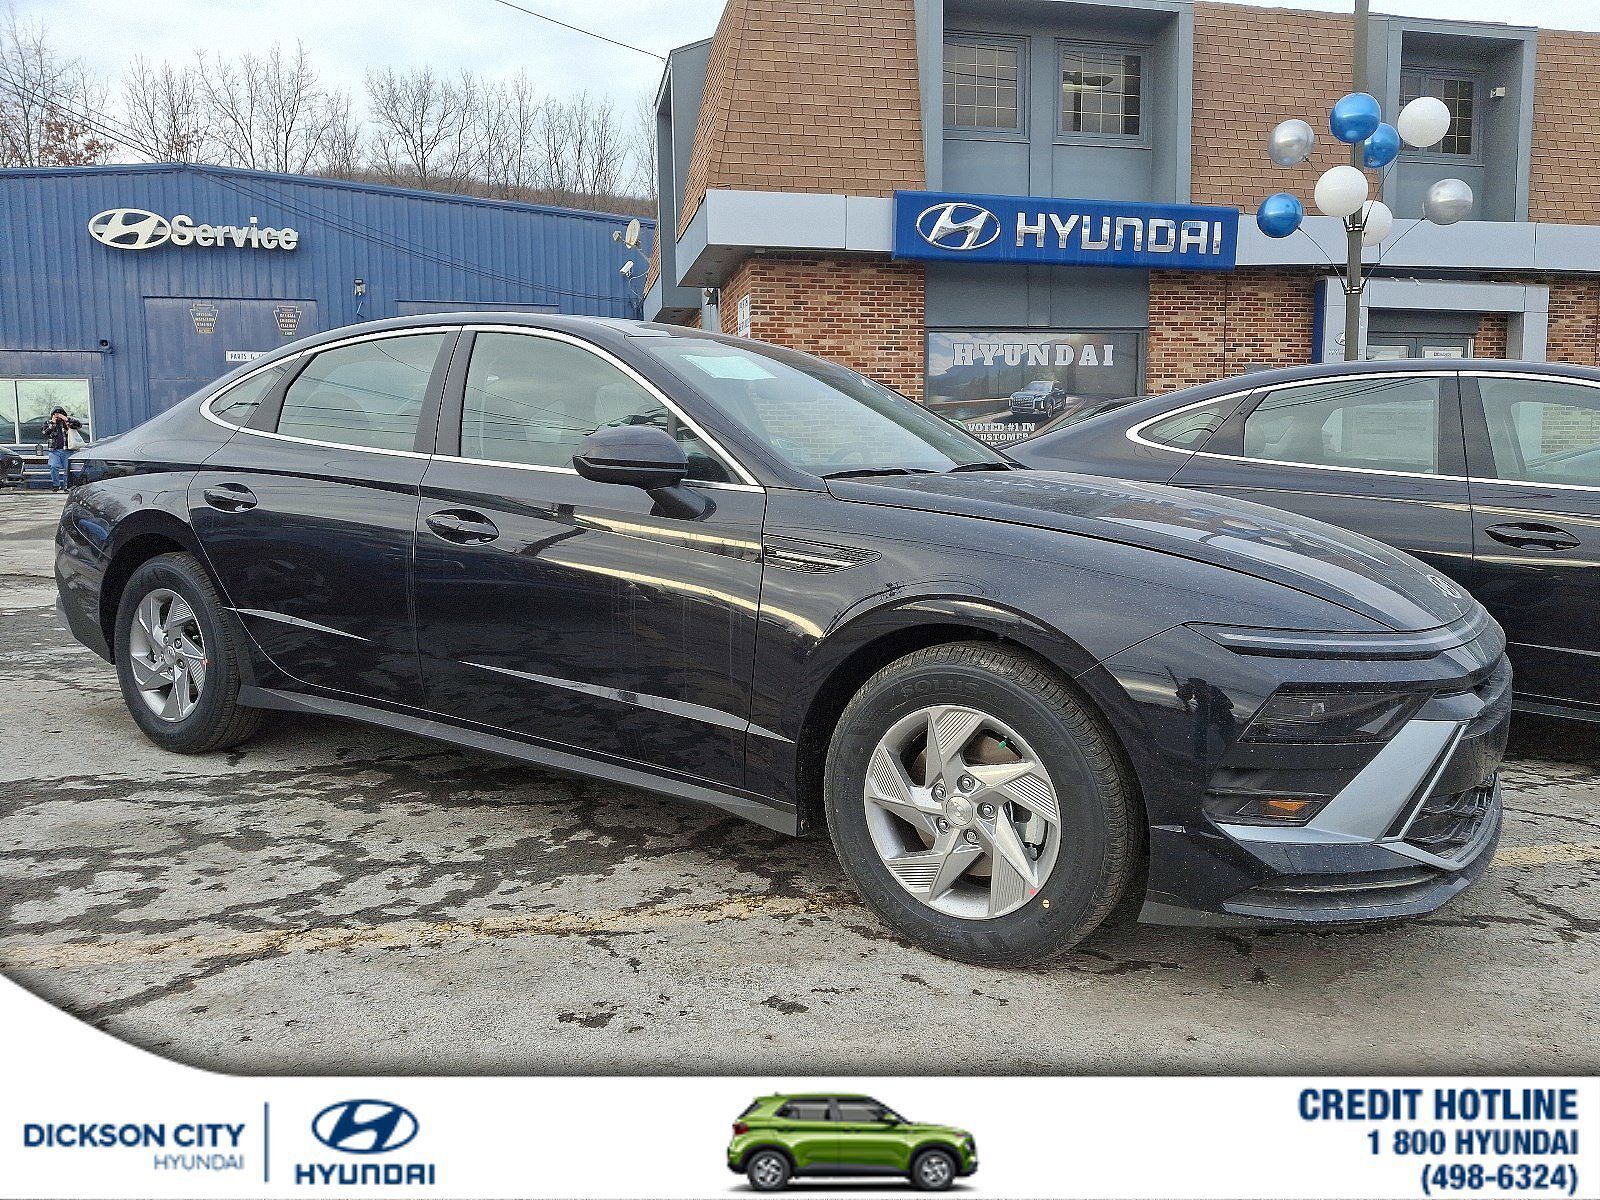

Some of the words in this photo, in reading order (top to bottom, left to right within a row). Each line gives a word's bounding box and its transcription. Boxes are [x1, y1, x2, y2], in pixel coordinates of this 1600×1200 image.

[170, 214, 298, 250] Service
[1016, 212, 1222, 255] HYUNDAI
[953, 343, 1114, 366] HYUNDAI
[967, 422, 1005, 432] VOTED
[1007, 422, 1020, 432] #1
[1021, 422, 1036, 432] IN
